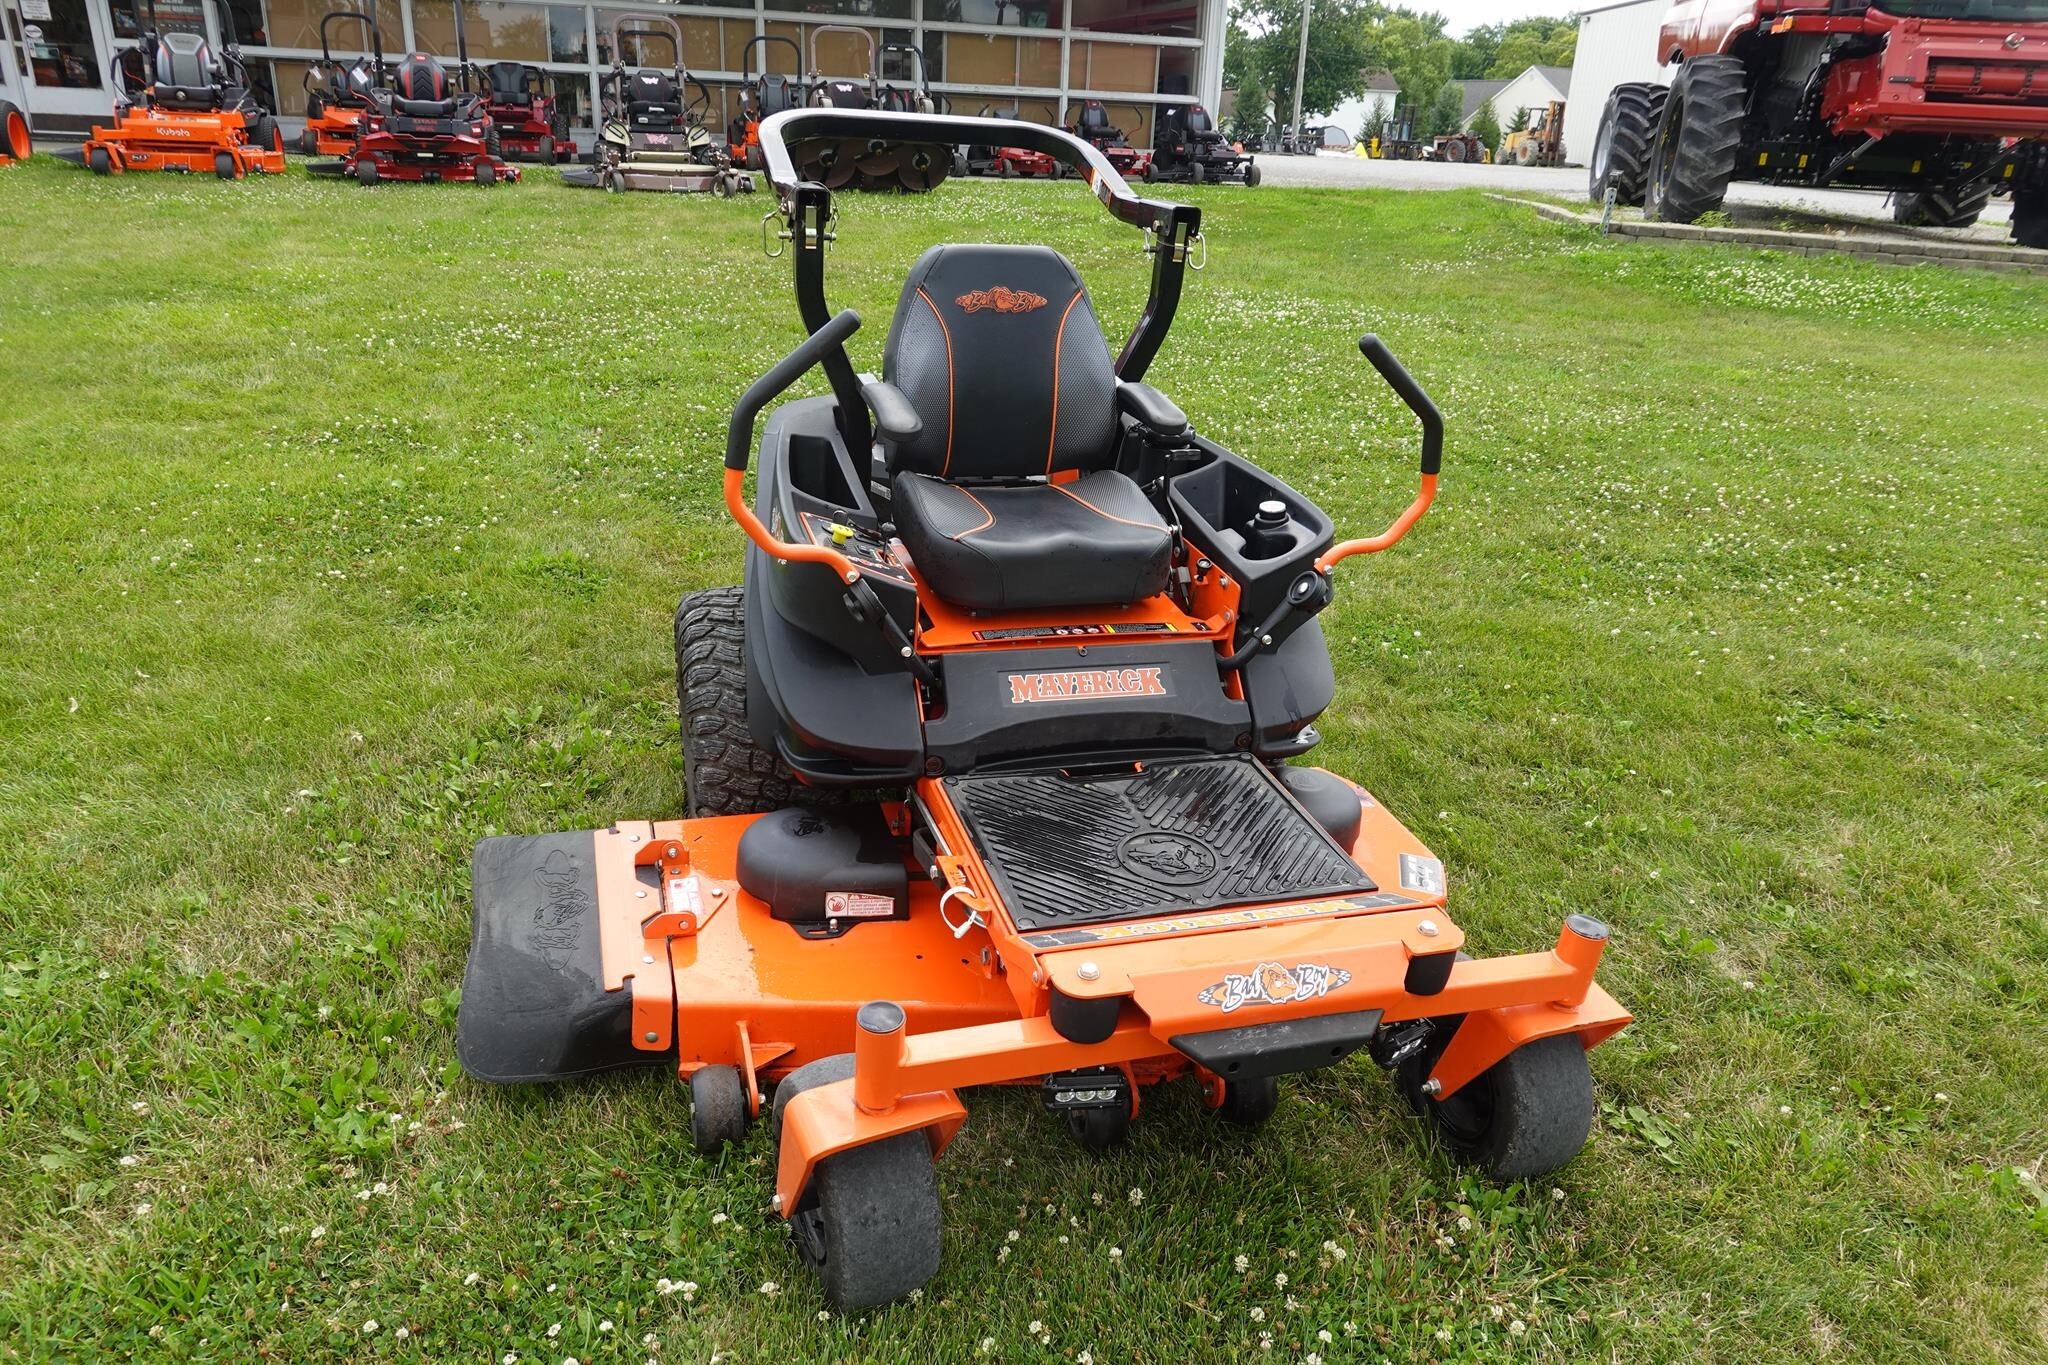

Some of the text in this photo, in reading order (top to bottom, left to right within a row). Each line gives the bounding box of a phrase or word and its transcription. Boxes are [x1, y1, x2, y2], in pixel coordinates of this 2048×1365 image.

[156, 126, 191, 138] Kubota
[1009, 667, 1167, 703] MAVERICK
[1222, 963, 1330, 1013] Bad Boy
